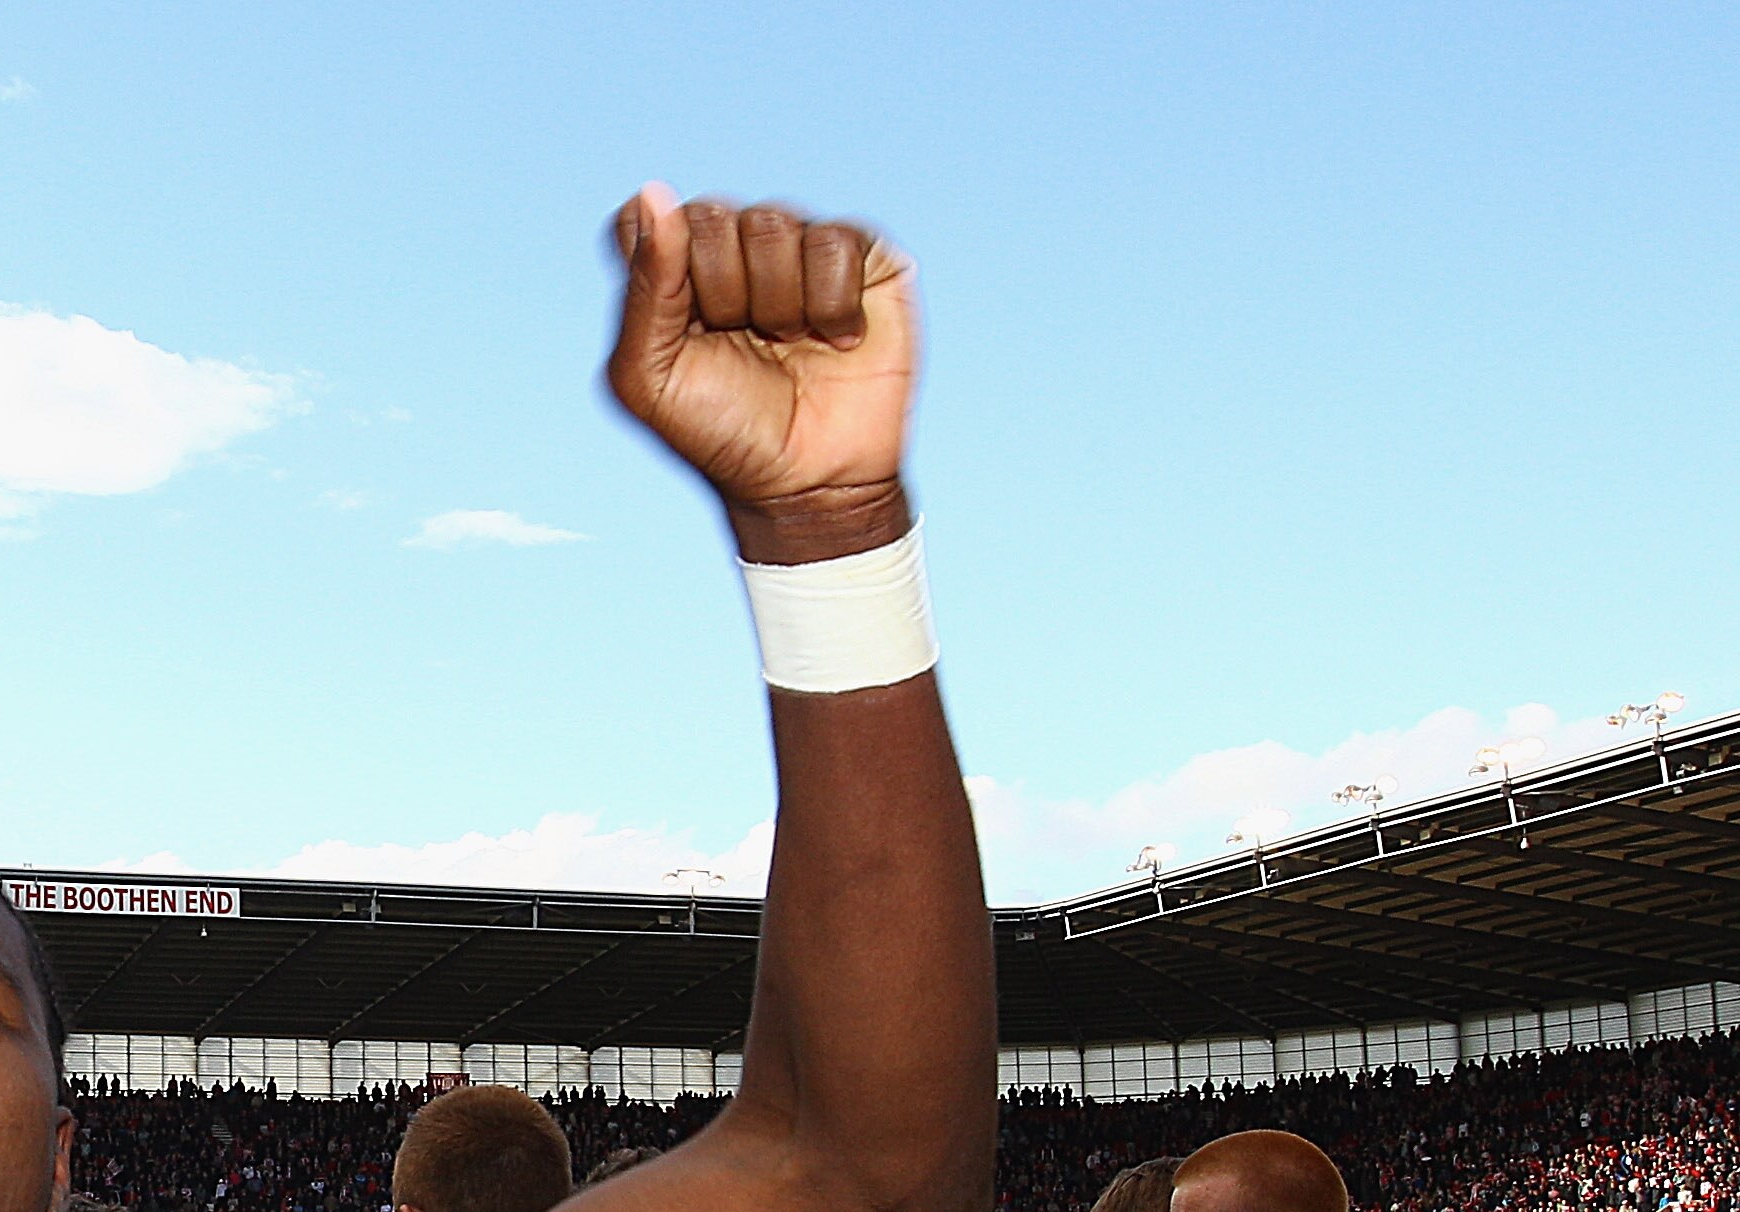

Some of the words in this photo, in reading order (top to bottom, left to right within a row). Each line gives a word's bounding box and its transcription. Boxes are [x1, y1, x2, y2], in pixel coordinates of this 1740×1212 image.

[10, 883, 57, 909] THE
[63, 886, 177, 913] BOOTHEN
[185, 890, 234, 914] END
